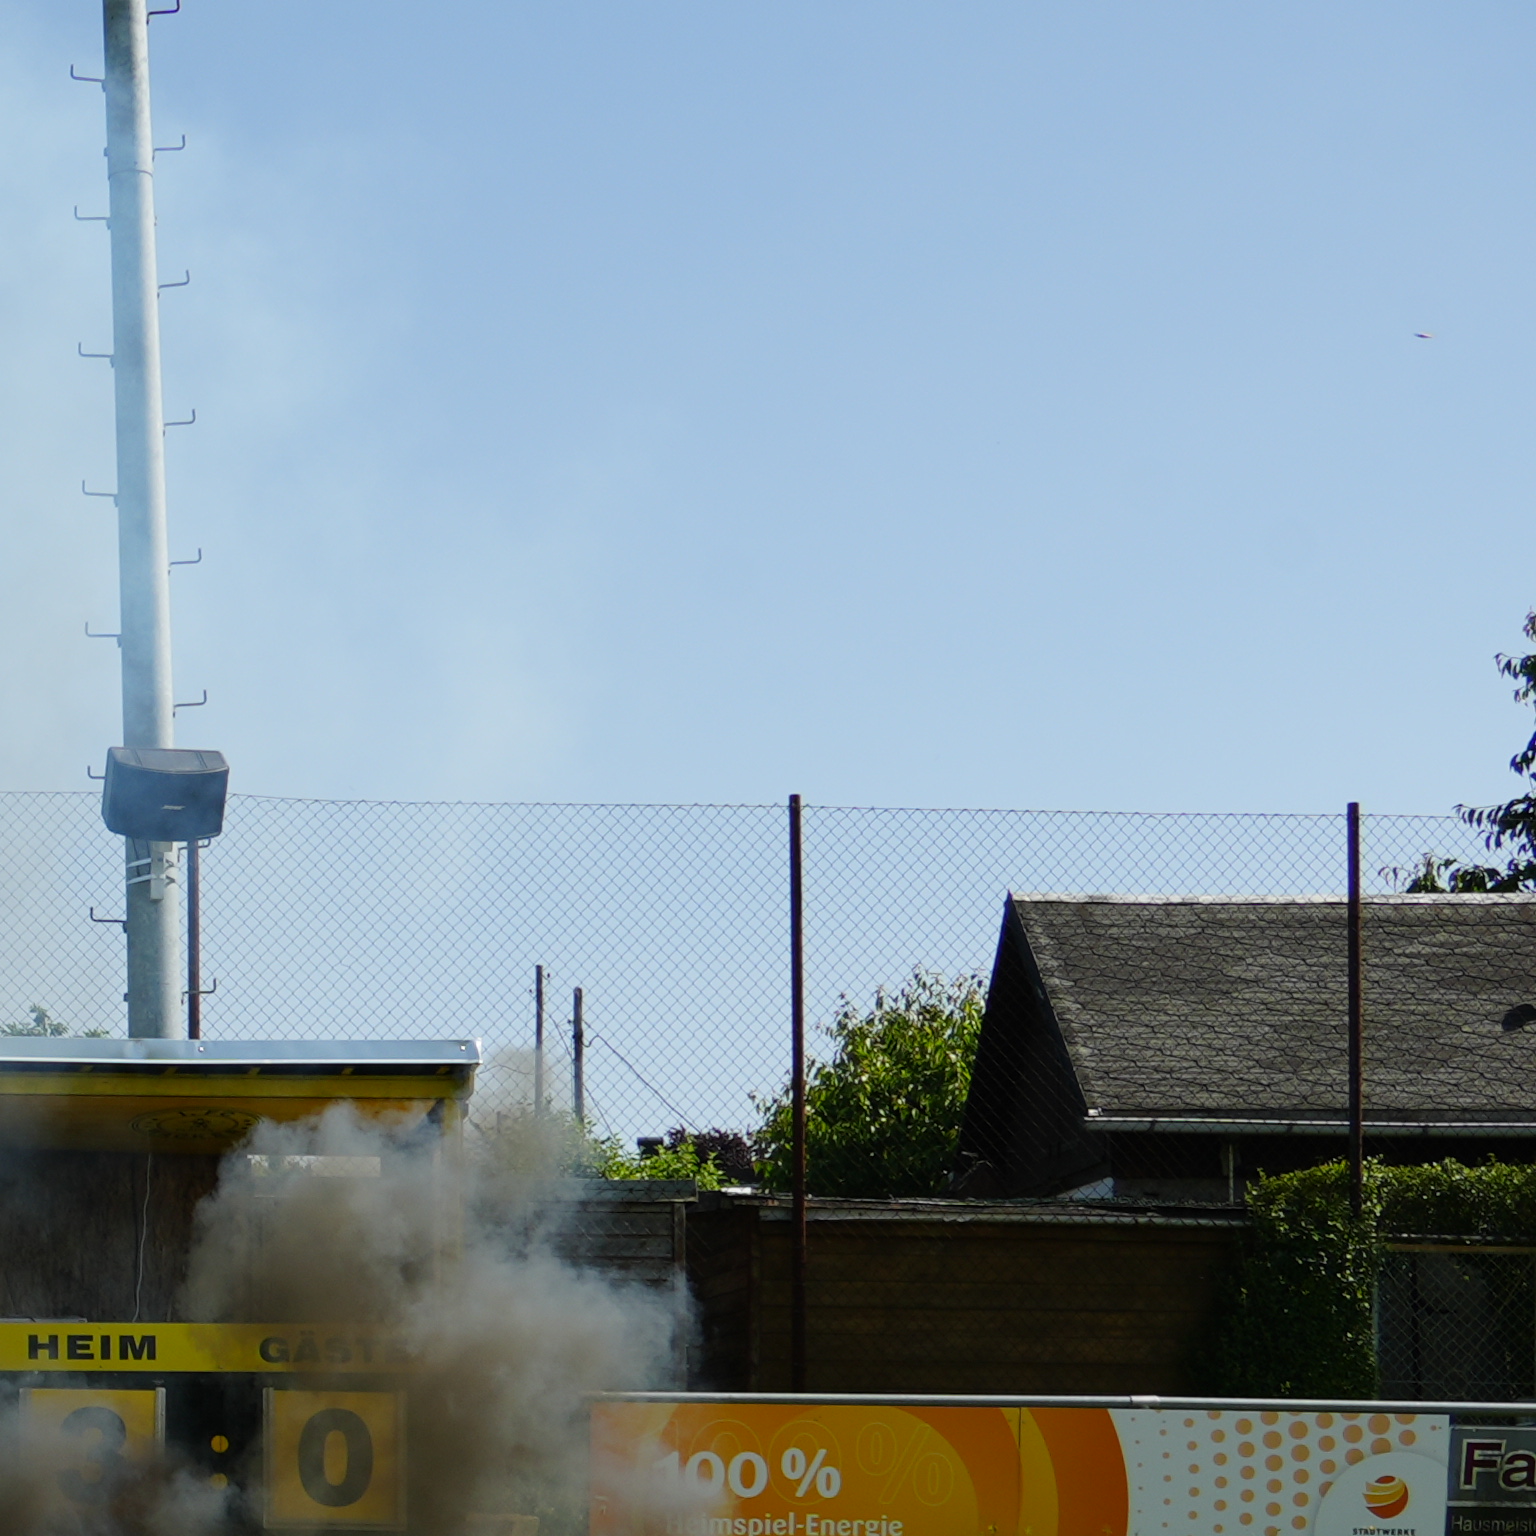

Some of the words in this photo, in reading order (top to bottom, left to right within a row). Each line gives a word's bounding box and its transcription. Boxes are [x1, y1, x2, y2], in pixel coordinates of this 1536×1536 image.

[27, 1334, 158, 1361] HEIM
[298, 1407, 375, 1507] 0
[652, 1450, 769, 1499] 100
[781, 1447, 842, 1499] %
[1352, 1528, 1416, 1536] STADTWERKE
